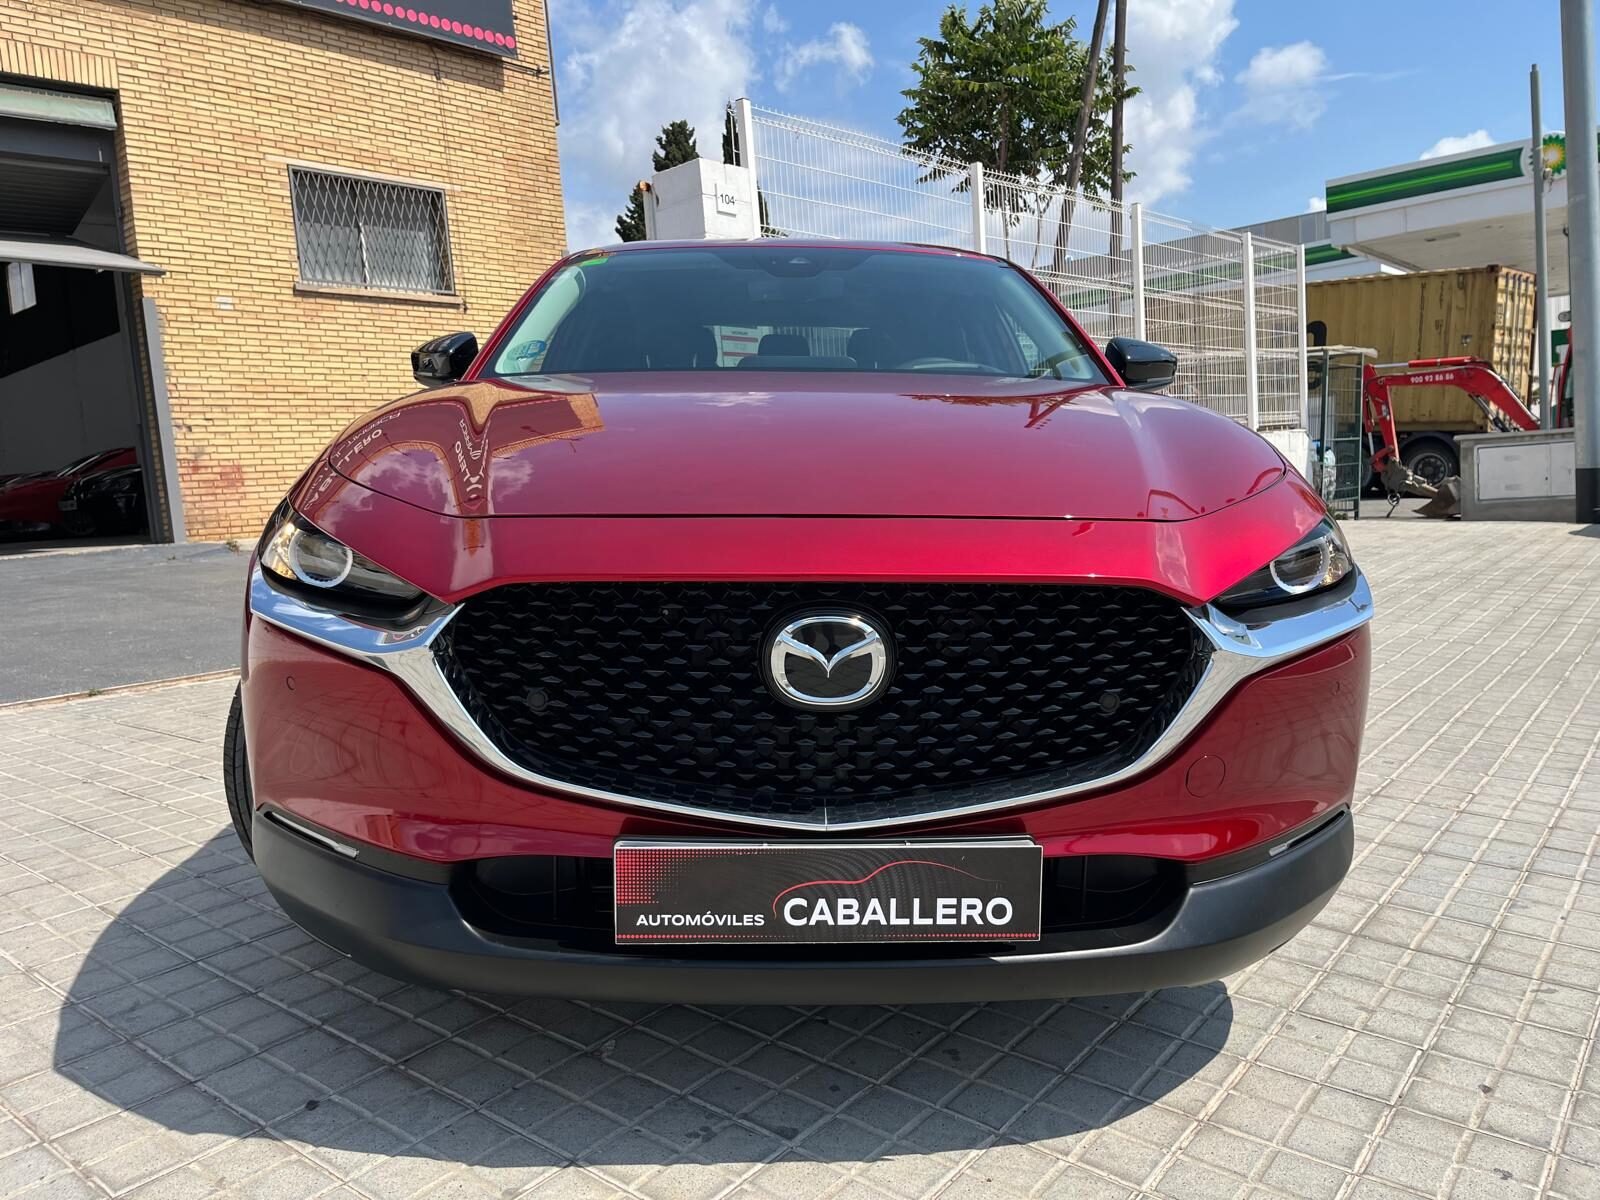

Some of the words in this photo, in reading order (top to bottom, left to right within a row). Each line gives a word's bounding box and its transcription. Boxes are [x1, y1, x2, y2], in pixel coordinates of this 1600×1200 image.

[719, 193, 735, 206] 104
[636, 911, 765, 927] AUTOMÓVILES
[783, 897, 1012, 926] CABALLERO
